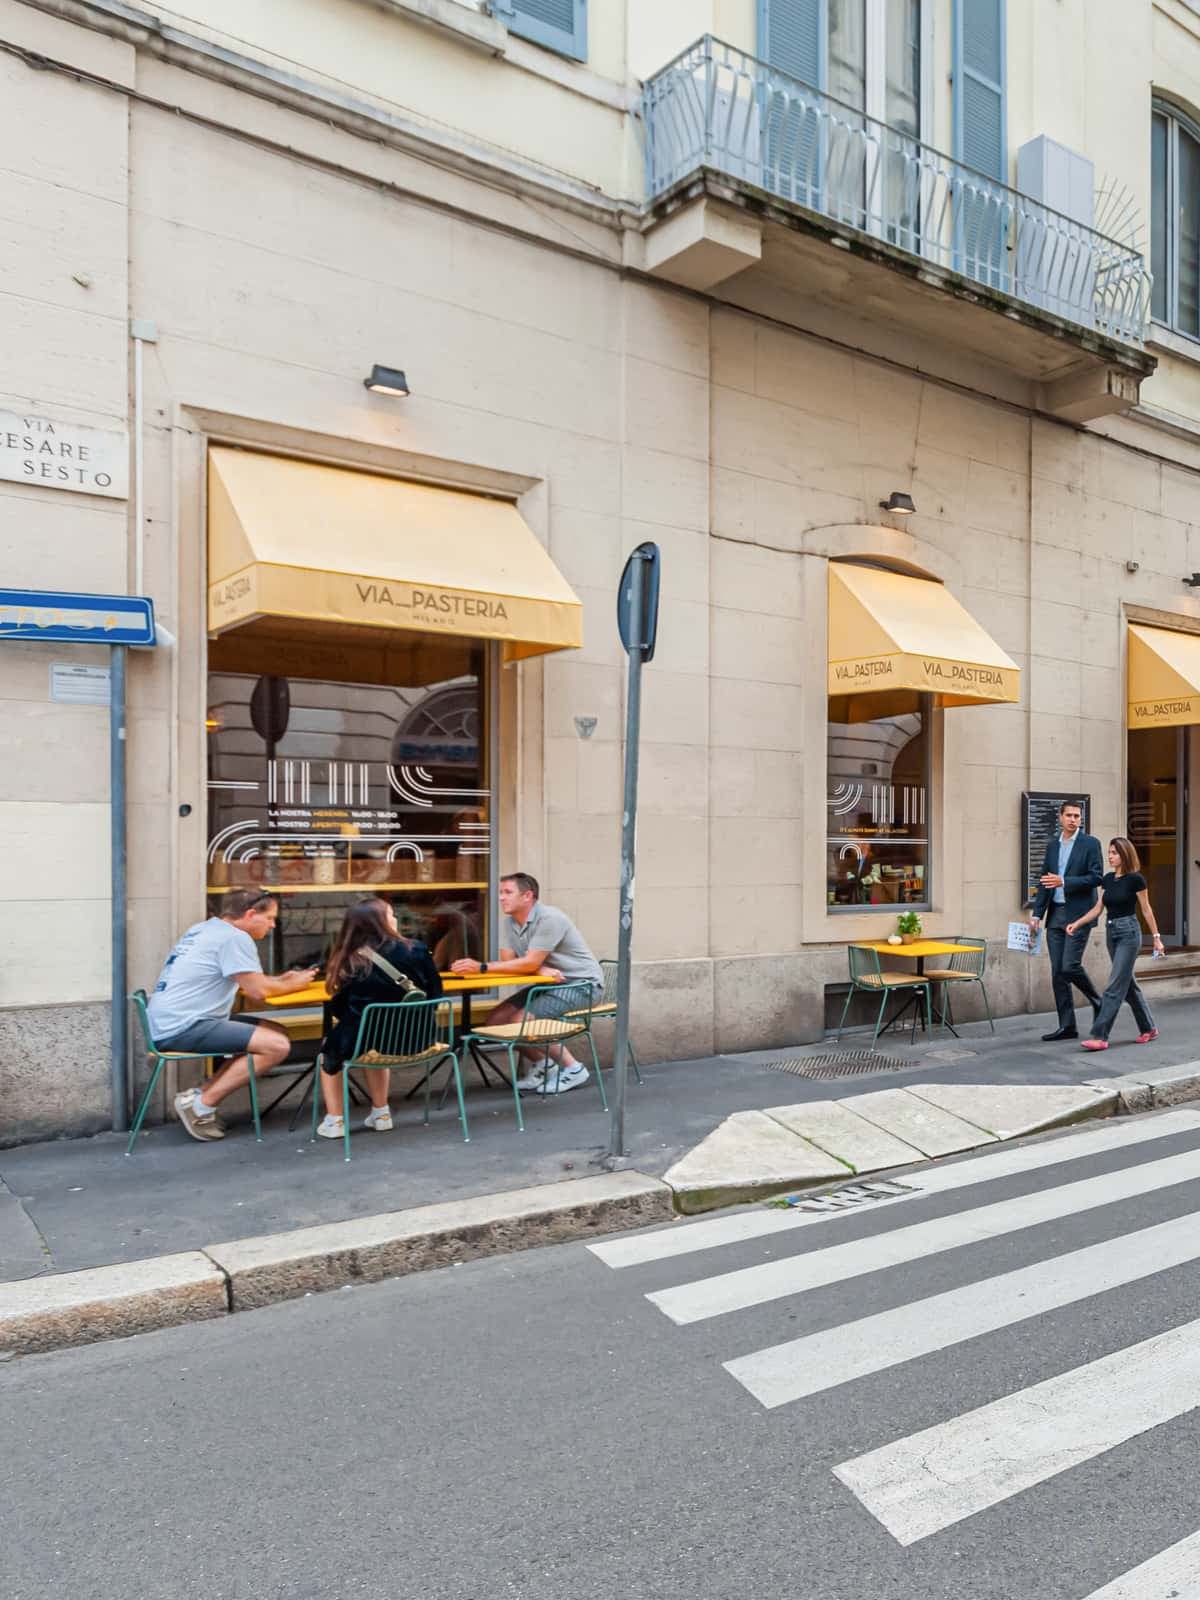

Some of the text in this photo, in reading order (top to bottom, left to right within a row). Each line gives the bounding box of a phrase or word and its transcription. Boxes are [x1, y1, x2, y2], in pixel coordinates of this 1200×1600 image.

[24, 418, 55, 434] VIA
[0, 432, 89, 461] ESARE
[24, 459, 111, 487] SESTO
